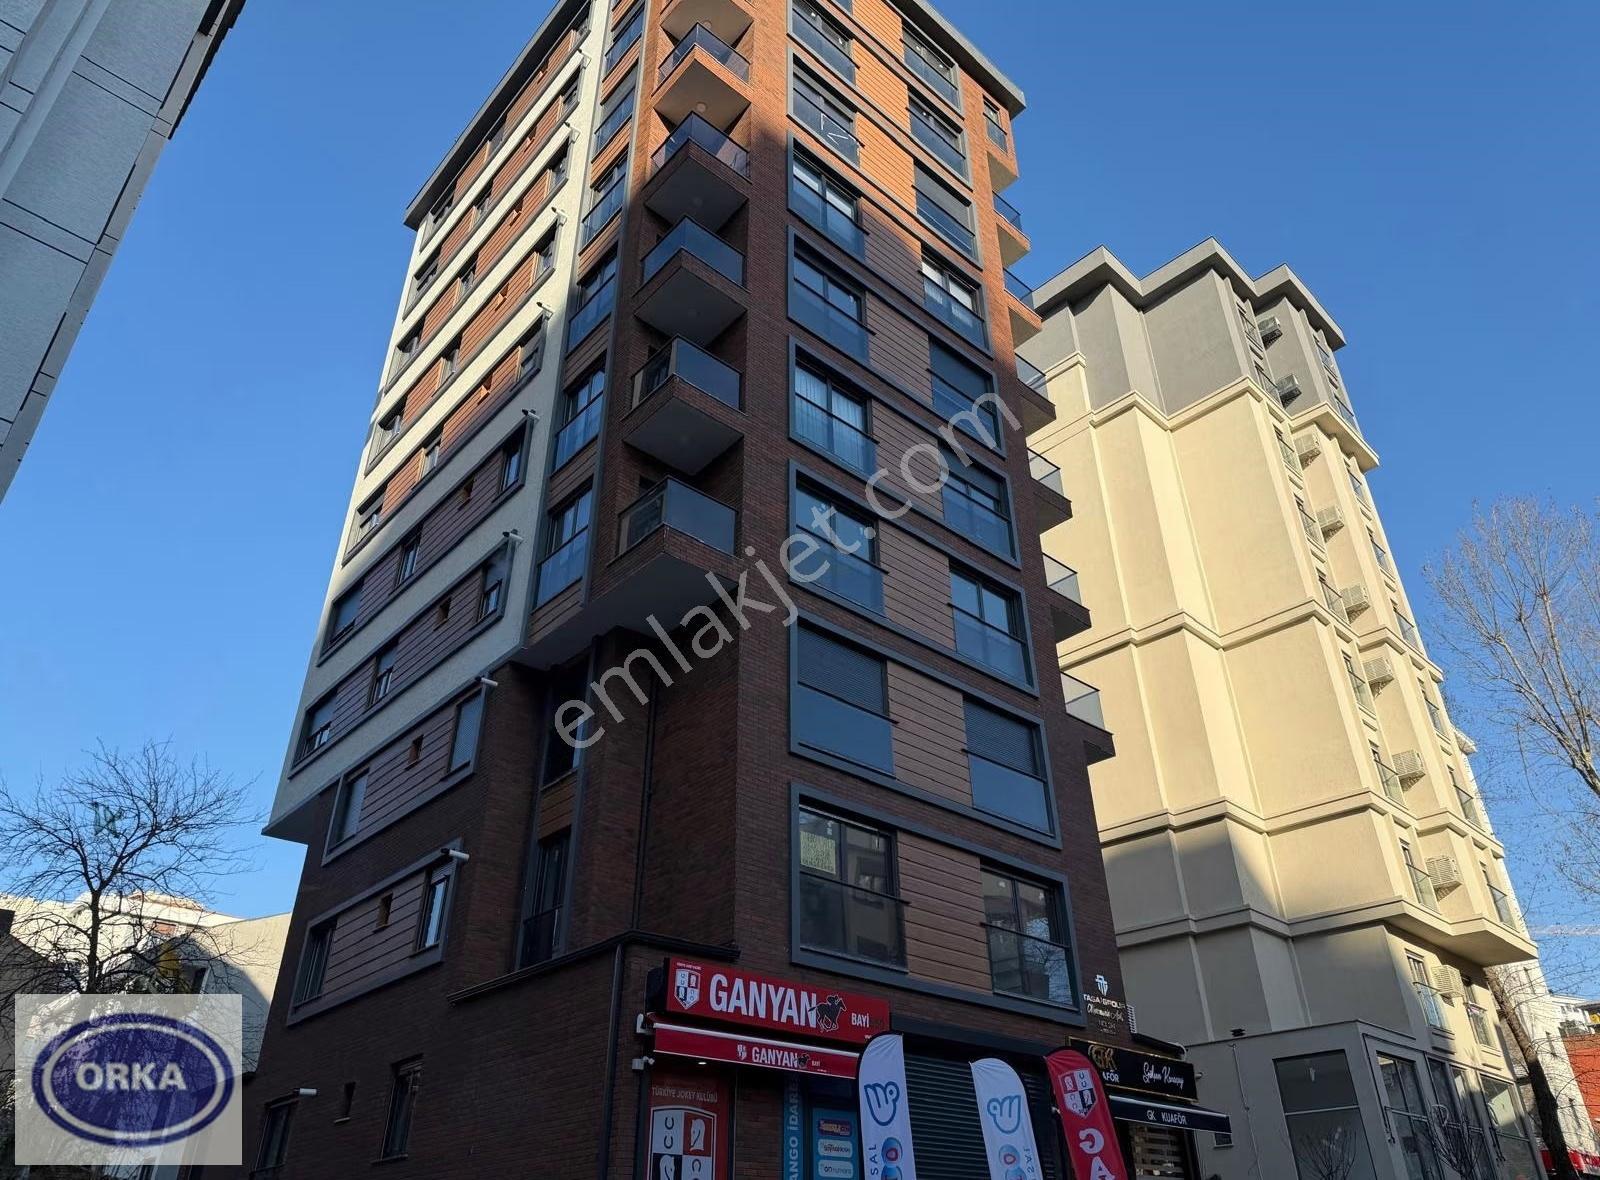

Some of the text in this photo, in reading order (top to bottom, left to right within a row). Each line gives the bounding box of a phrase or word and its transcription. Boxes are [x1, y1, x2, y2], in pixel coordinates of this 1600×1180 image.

[709, 972, 870, 1028] GANYAN BAYİ
[752, 1046, 798, 1068] GANYAN
